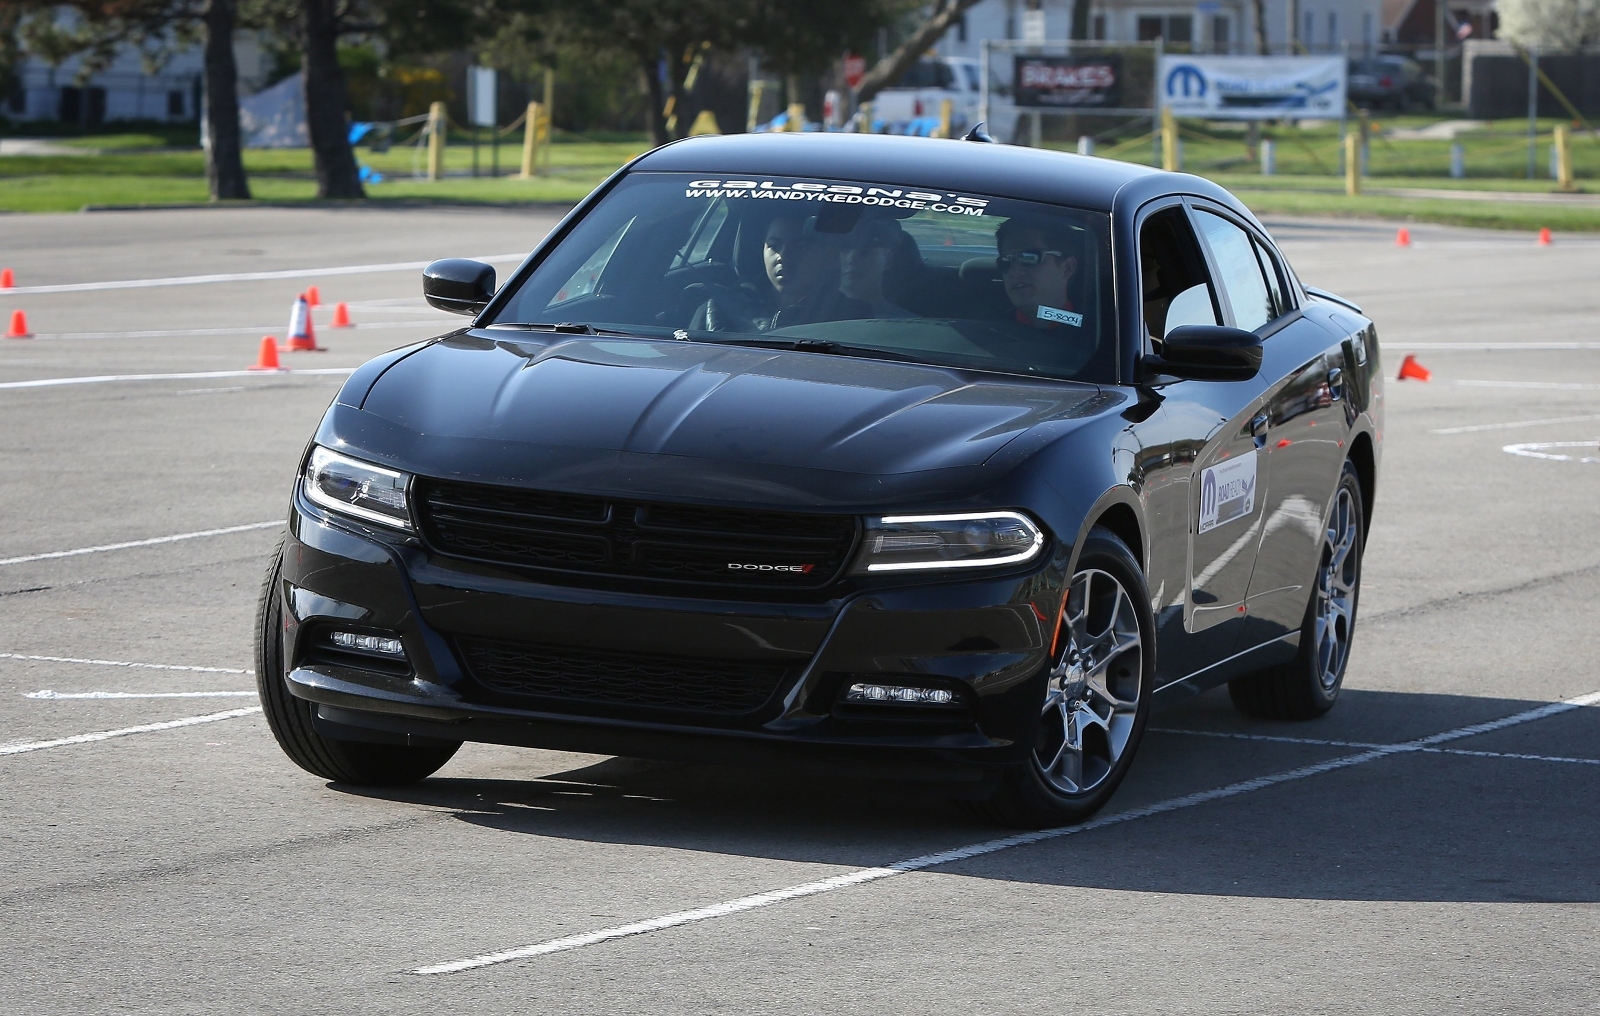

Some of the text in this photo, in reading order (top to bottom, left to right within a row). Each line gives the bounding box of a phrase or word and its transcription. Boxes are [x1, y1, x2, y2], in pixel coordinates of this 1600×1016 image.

[685, 189, 984, 216] WWW.VANDYKEDODGE.COM
[1044, 310, 1079, 324] 5-8004
[1218, 482, 1230, 502] ROAD
[728, 563, 803, 572] DODGE
